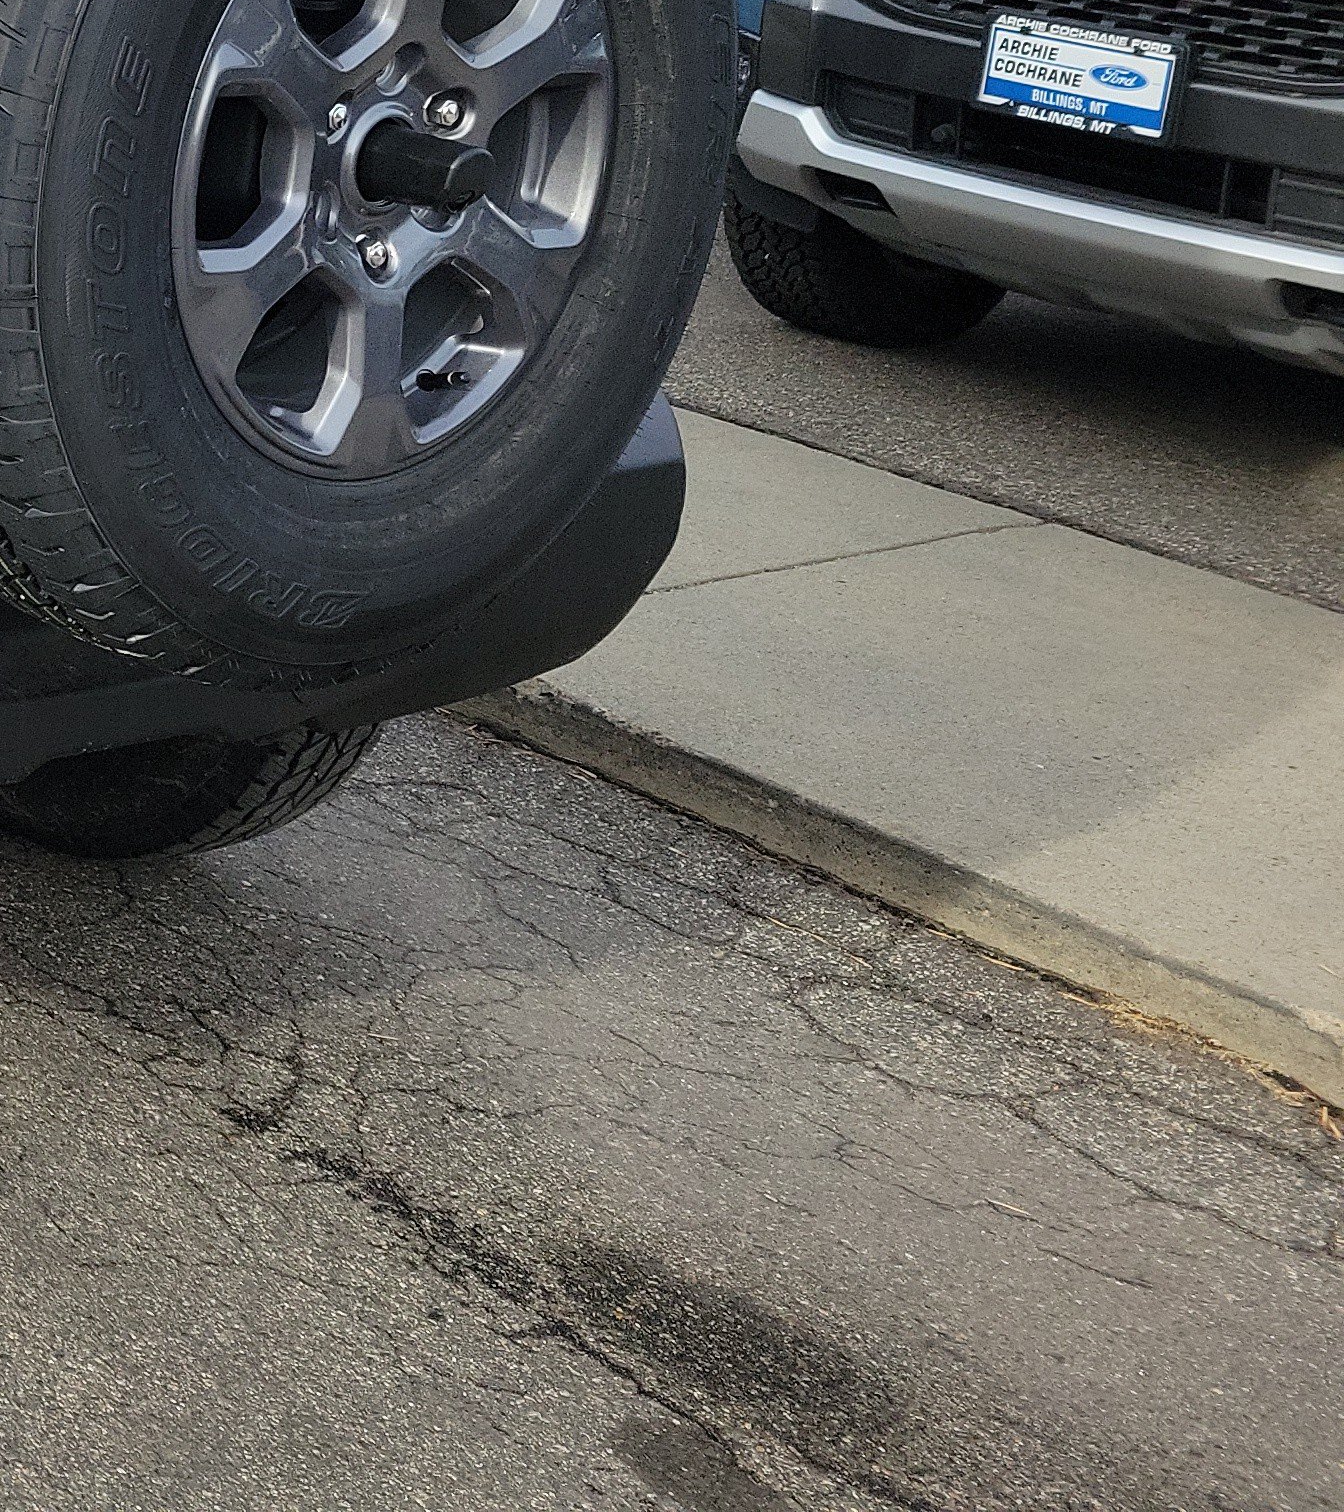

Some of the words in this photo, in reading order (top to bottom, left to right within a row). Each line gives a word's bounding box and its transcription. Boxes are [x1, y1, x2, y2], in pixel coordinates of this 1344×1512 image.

[996, 14, 1048, 32] ARCHIE
[1050, 24, 1129, 47] COCHRANE
[1130, 40, 1172, 55] FORD
[998, 37, 1059, 61] ARCHIE
[994, 58, 1083, 88] COCHRANE
[1100, 67, 1138, 87] Ford
[1031, 89, 1086, 113] BILLINGS,
[1090, 102, 1110, 116] MT
[1016, 105, 1087, 130] BILLINGS,
[1089, 119, 1116, 135] MT
